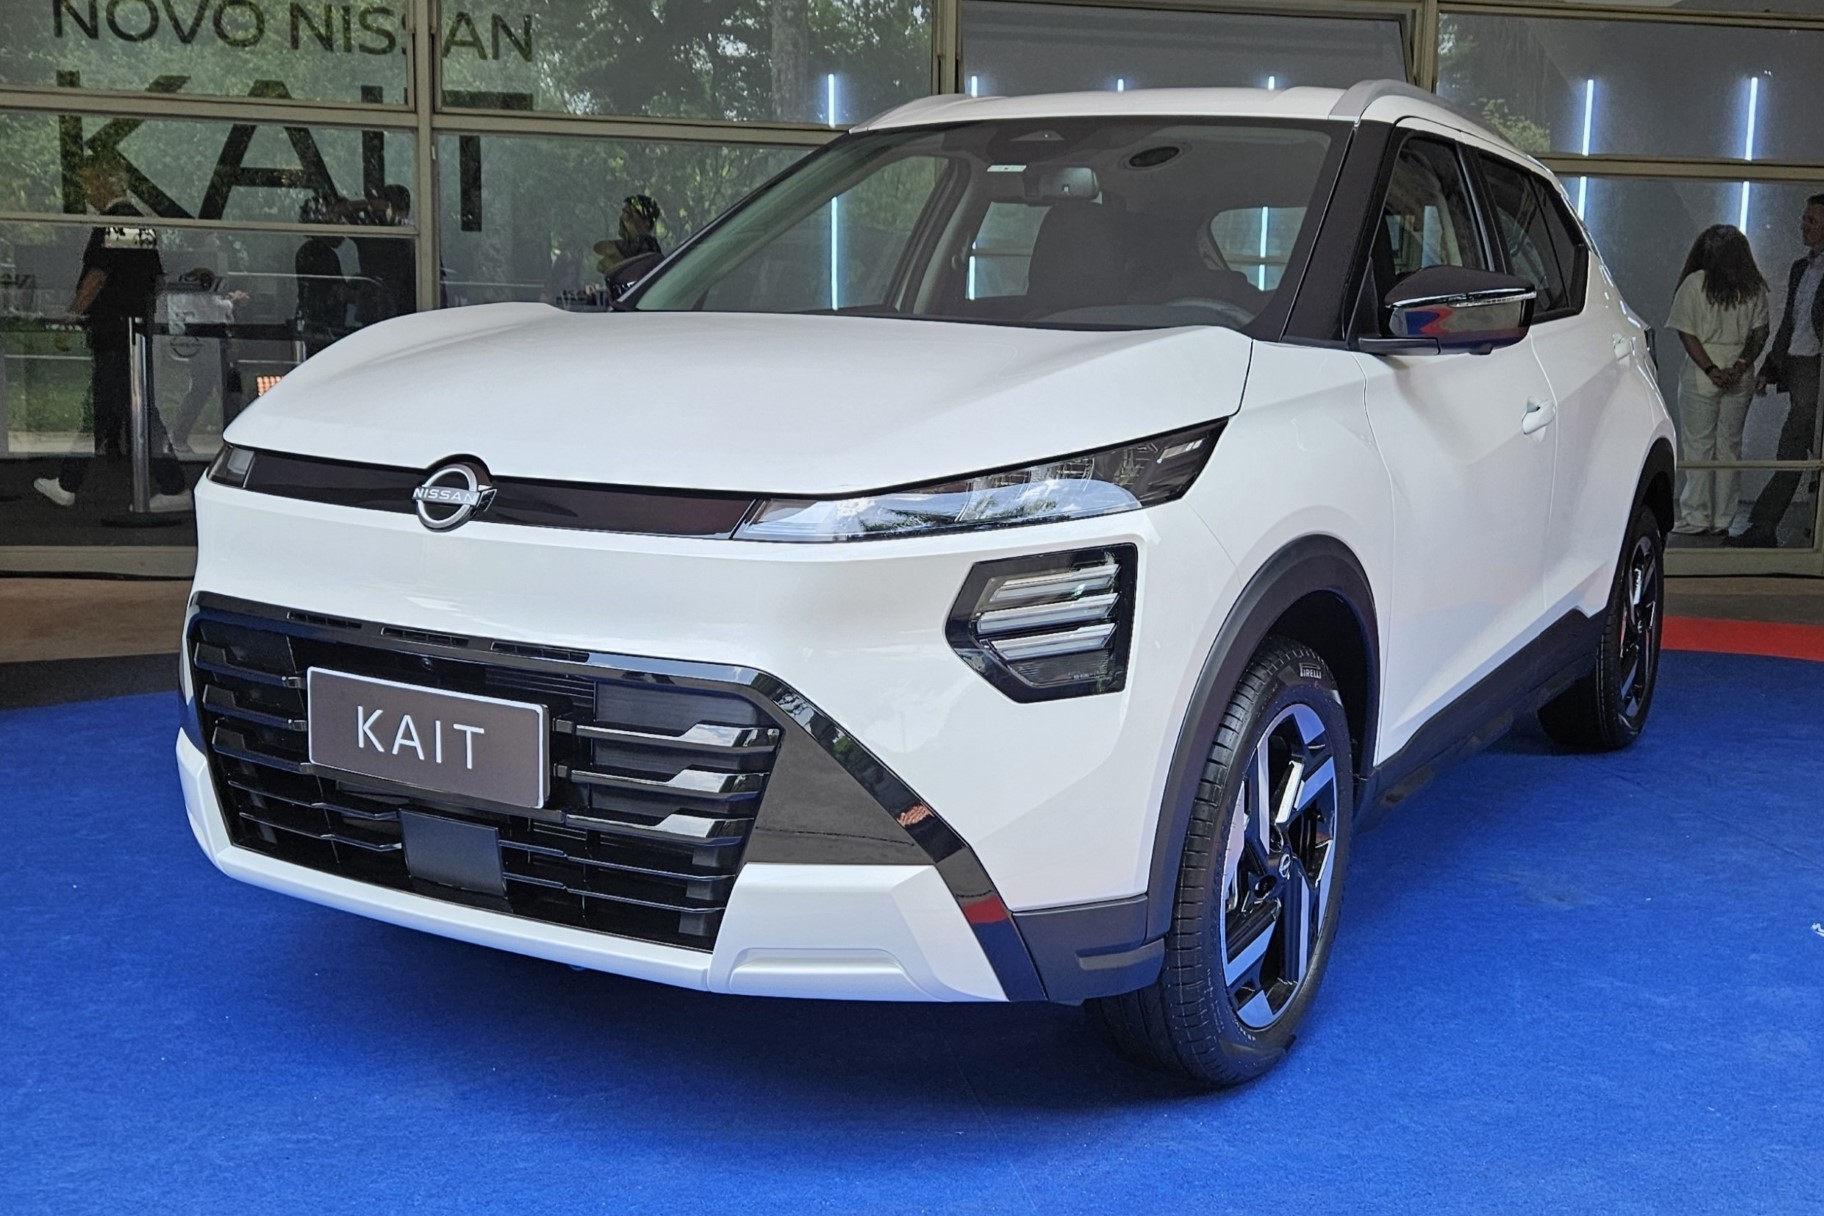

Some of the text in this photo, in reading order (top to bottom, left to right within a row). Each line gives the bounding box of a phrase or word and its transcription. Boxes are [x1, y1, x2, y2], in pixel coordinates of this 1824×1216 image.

[53, 0, 533, 62] NOVO NISAN
[56, 70, 534, 232] KAIT
[412, 487, 477, 504] NISSAN
[1299, 662, 1322, 680] PIRELLI
[357, 705, 485, 770] KAIT
